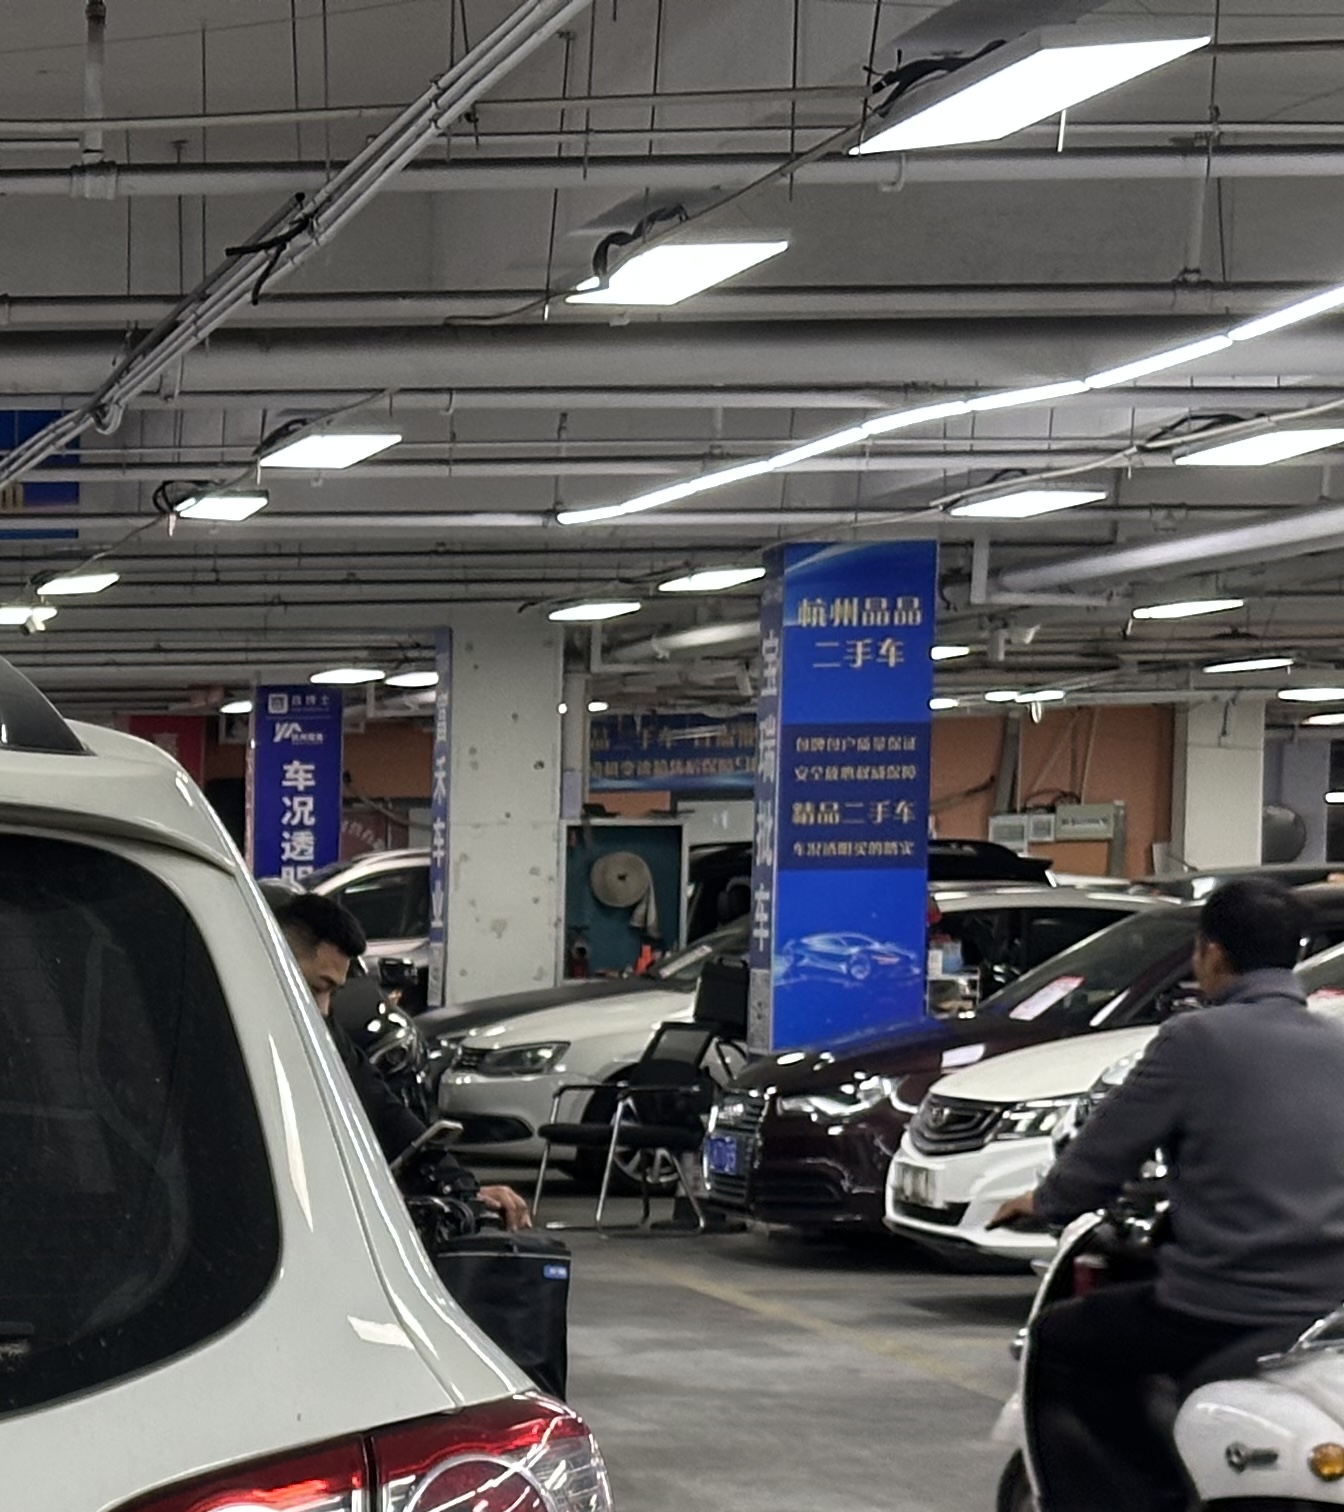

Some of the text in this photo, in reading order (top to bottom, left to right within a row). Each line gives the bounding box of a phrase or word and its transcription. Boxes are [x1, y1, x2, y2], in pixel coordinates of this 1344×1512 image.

[797, 597, 921, 627] 杭州晶晶
[813, 637, 905, 668] 二手车
[792, 801, 916, 826] 精品二手车
